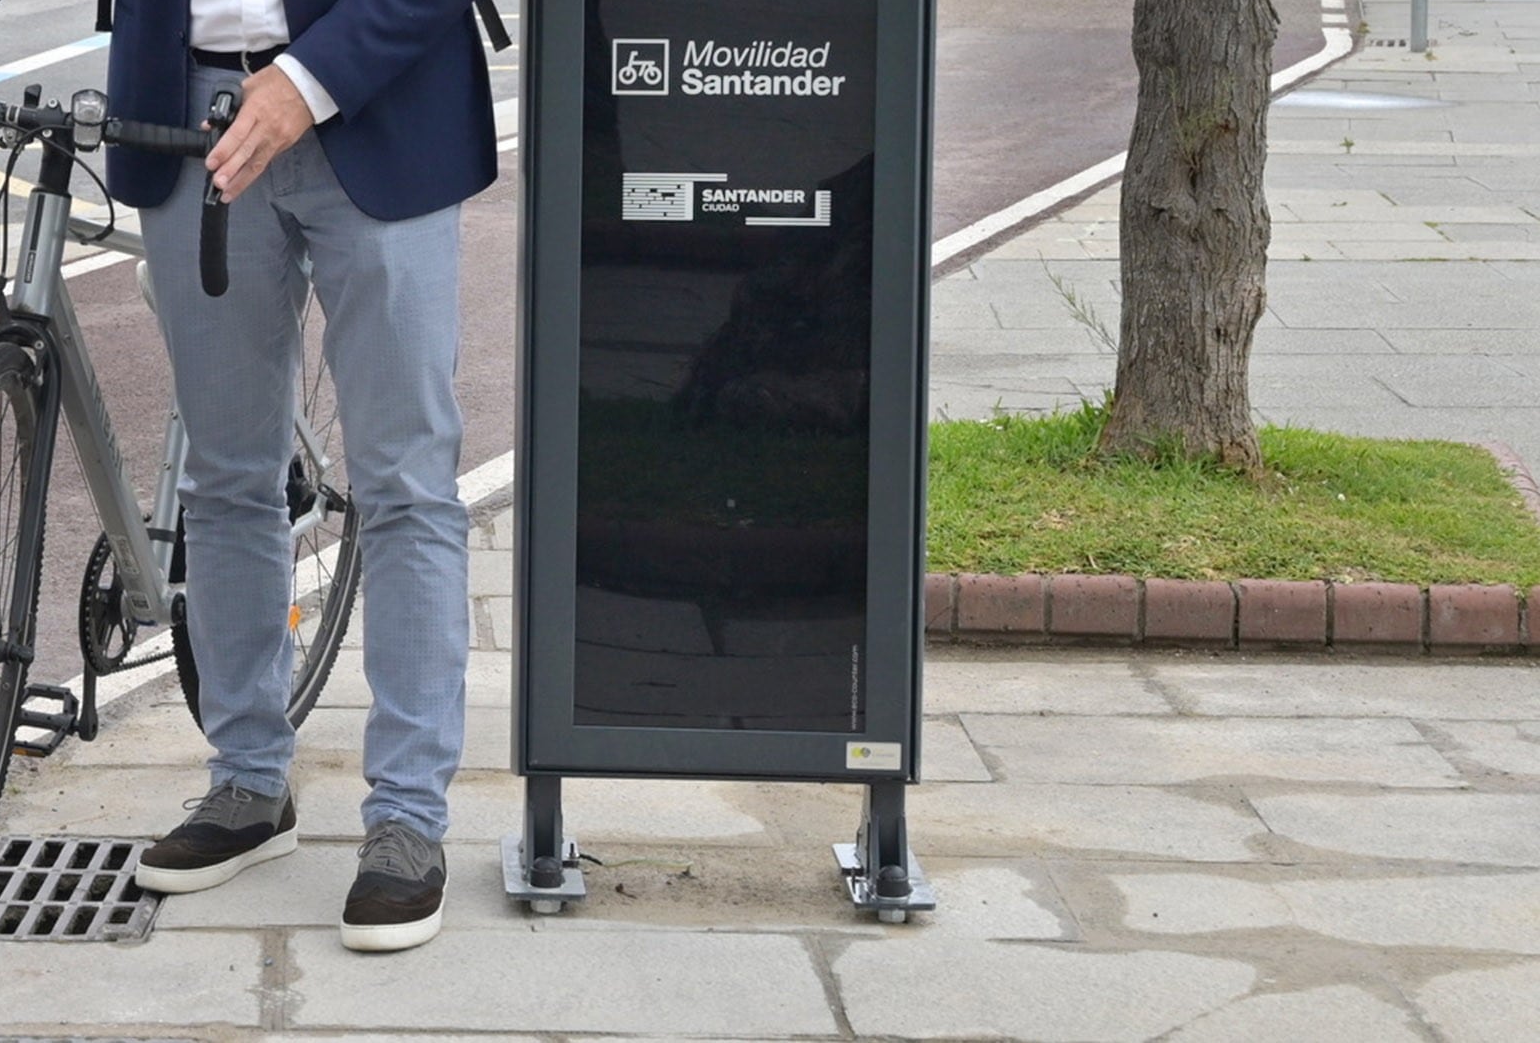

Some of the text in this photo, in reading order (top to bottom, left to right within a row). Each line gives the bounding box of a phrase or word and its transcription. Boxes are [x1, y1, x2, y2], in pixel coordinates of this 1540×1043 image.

[683, 40, 831, 68] Movilidad
[681, 68, 846, 96] Santander
[702, 189, 805, 204] SANTANDER
[702, 203, 740, 212] CIUDAD
